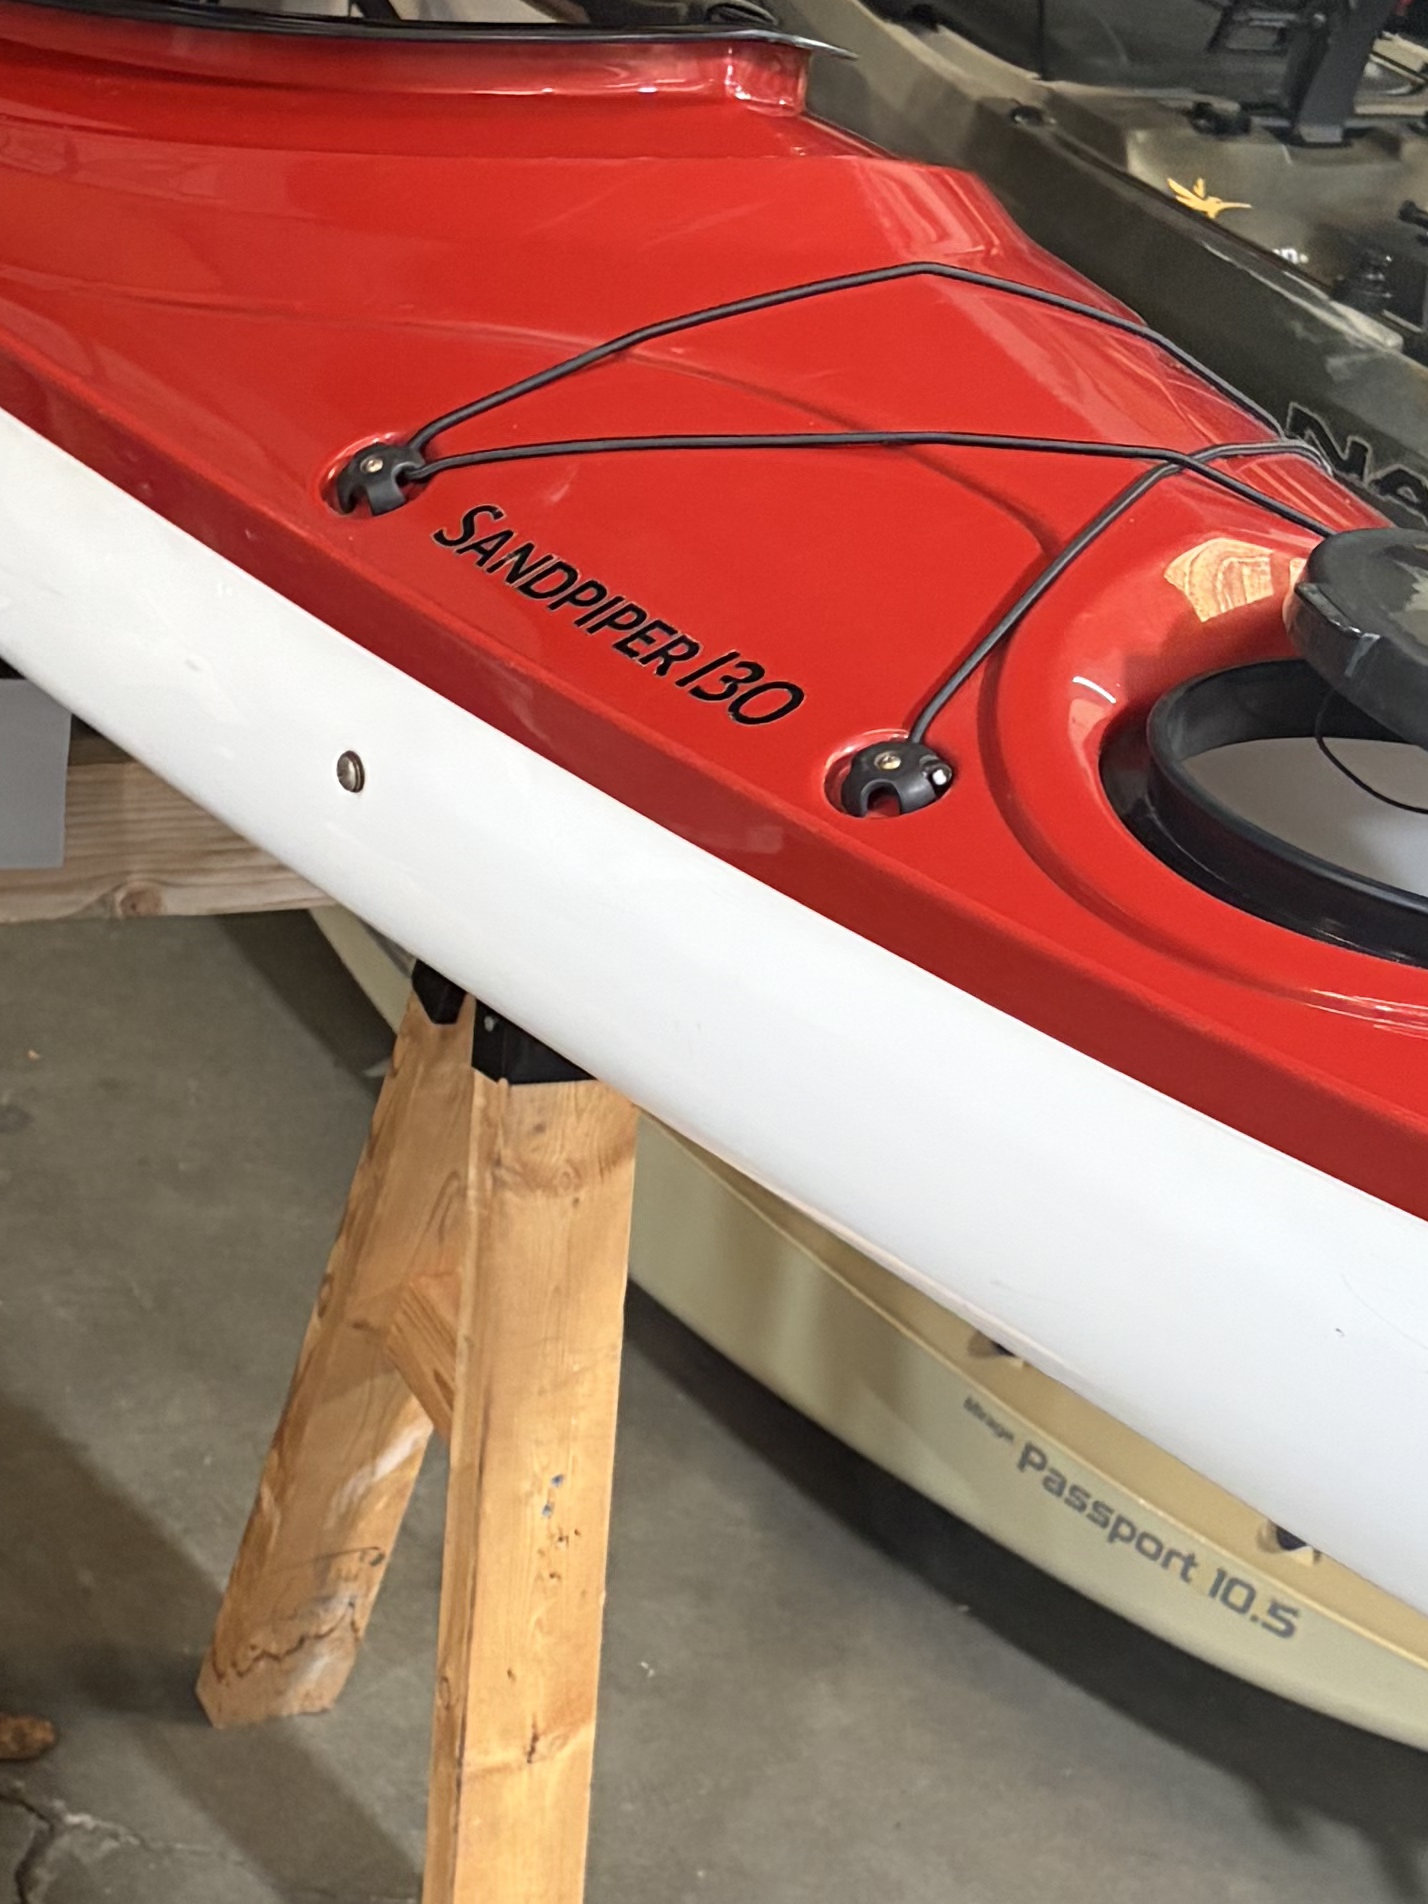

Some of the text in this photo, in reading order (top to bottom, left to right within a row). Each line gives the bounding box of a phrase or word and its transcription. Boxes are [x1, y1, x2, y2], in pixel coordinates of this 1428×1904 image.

[432, 503, 806, 726] SANDPIPER 130
[1017, 1440, 1301, 1640] Passport 10.5
